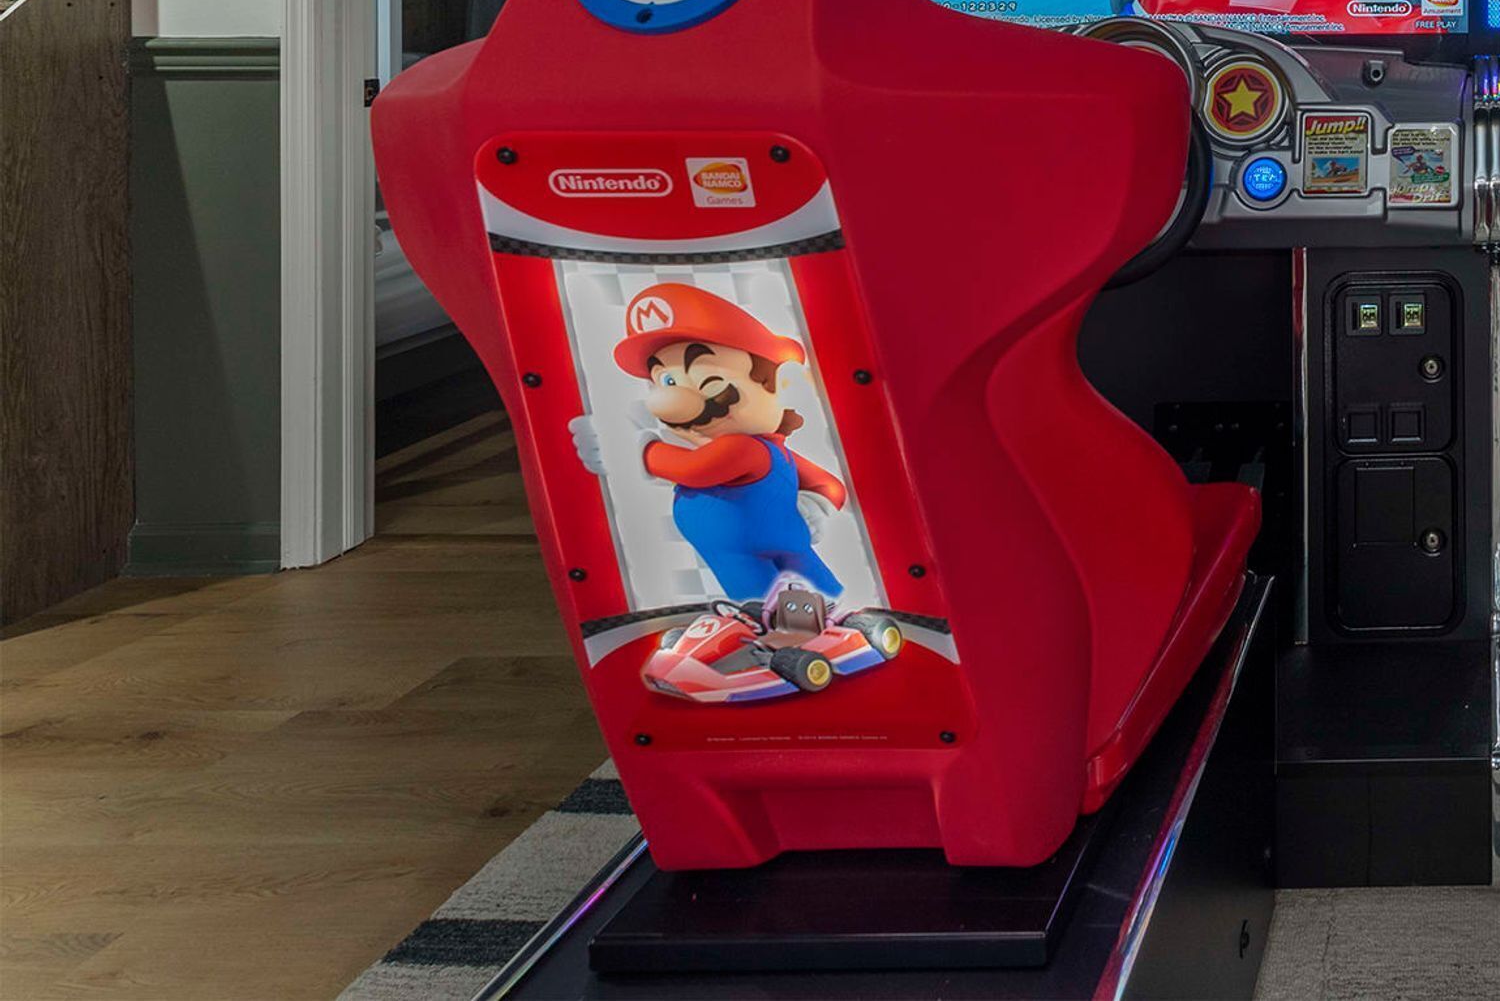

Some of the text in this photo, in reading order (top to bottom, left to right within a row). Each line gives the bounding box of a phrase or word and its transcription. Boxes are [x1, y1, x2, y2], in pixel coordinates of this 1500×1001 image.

[1352, 3, 1407, 13] Nintendo
[1415, 20, 1457, 28] FREE PLAY
[1307, 116, 1367, 135] Jump!!
[701, 172, 742, 181] BANDAI
[558, 175, 661, 191] Nintendo
[702, 180, 743, 189] NAMCO
[706, 197, 744, 205] Games
[636, 300, 670, 331] M
